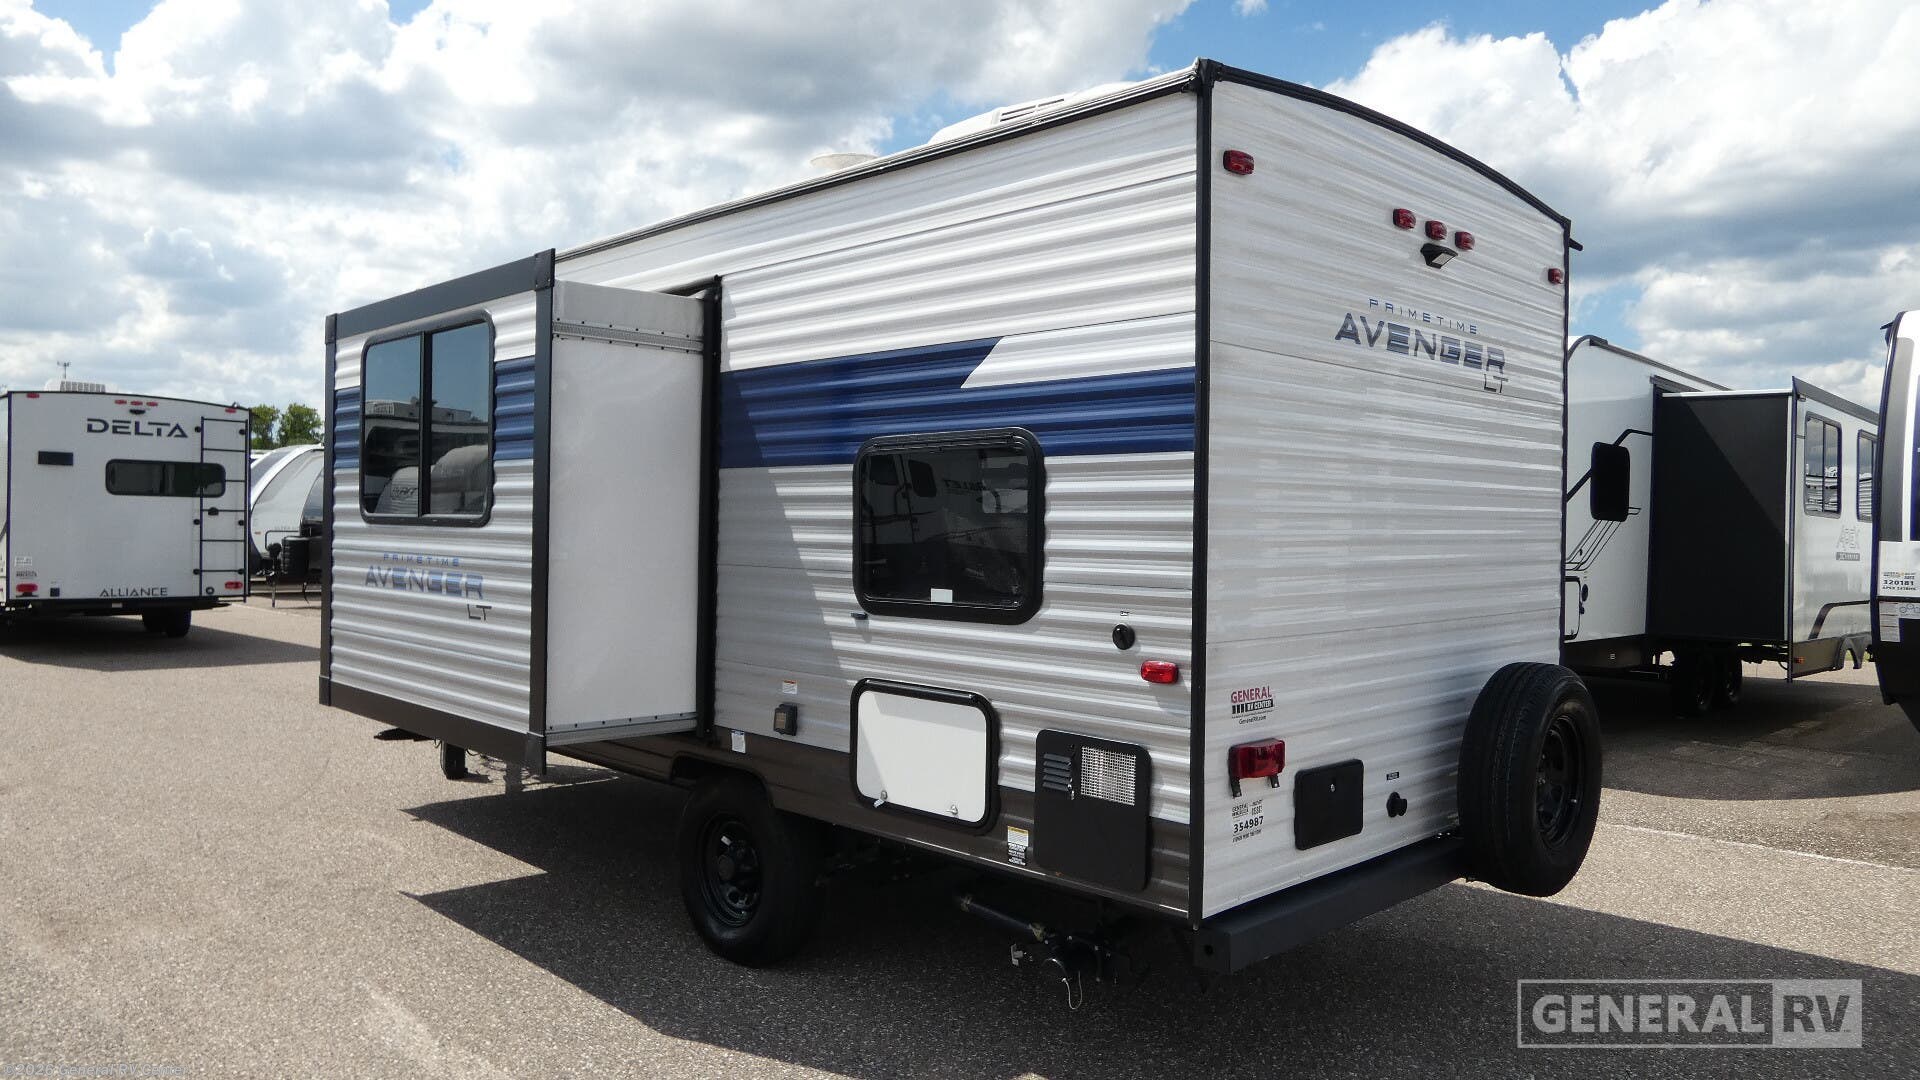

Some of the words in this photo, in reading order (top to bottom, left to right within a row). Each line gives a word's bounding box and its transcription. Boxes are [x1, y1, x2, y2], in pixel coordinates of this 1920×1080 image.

[1368, 298, 1477, 335] PRIMETIME
[1334, 312, 1506, 375] AVENGER
[1483, 373, 1509, 394] LT
[87, 418, 188, 438] DELTA
[383, 553, 460, 566] PRIMETIME
[365, 565, 483, 599] AVENGER
[99, 587, 169, 598] ALLIANCE
[466, 603, 493, 621] LT
[1231, 685, 1272, 703] GENERAL
[1254, 699, 1272, 710] CENTER
[1233, 815, 1264, 834] 354987
